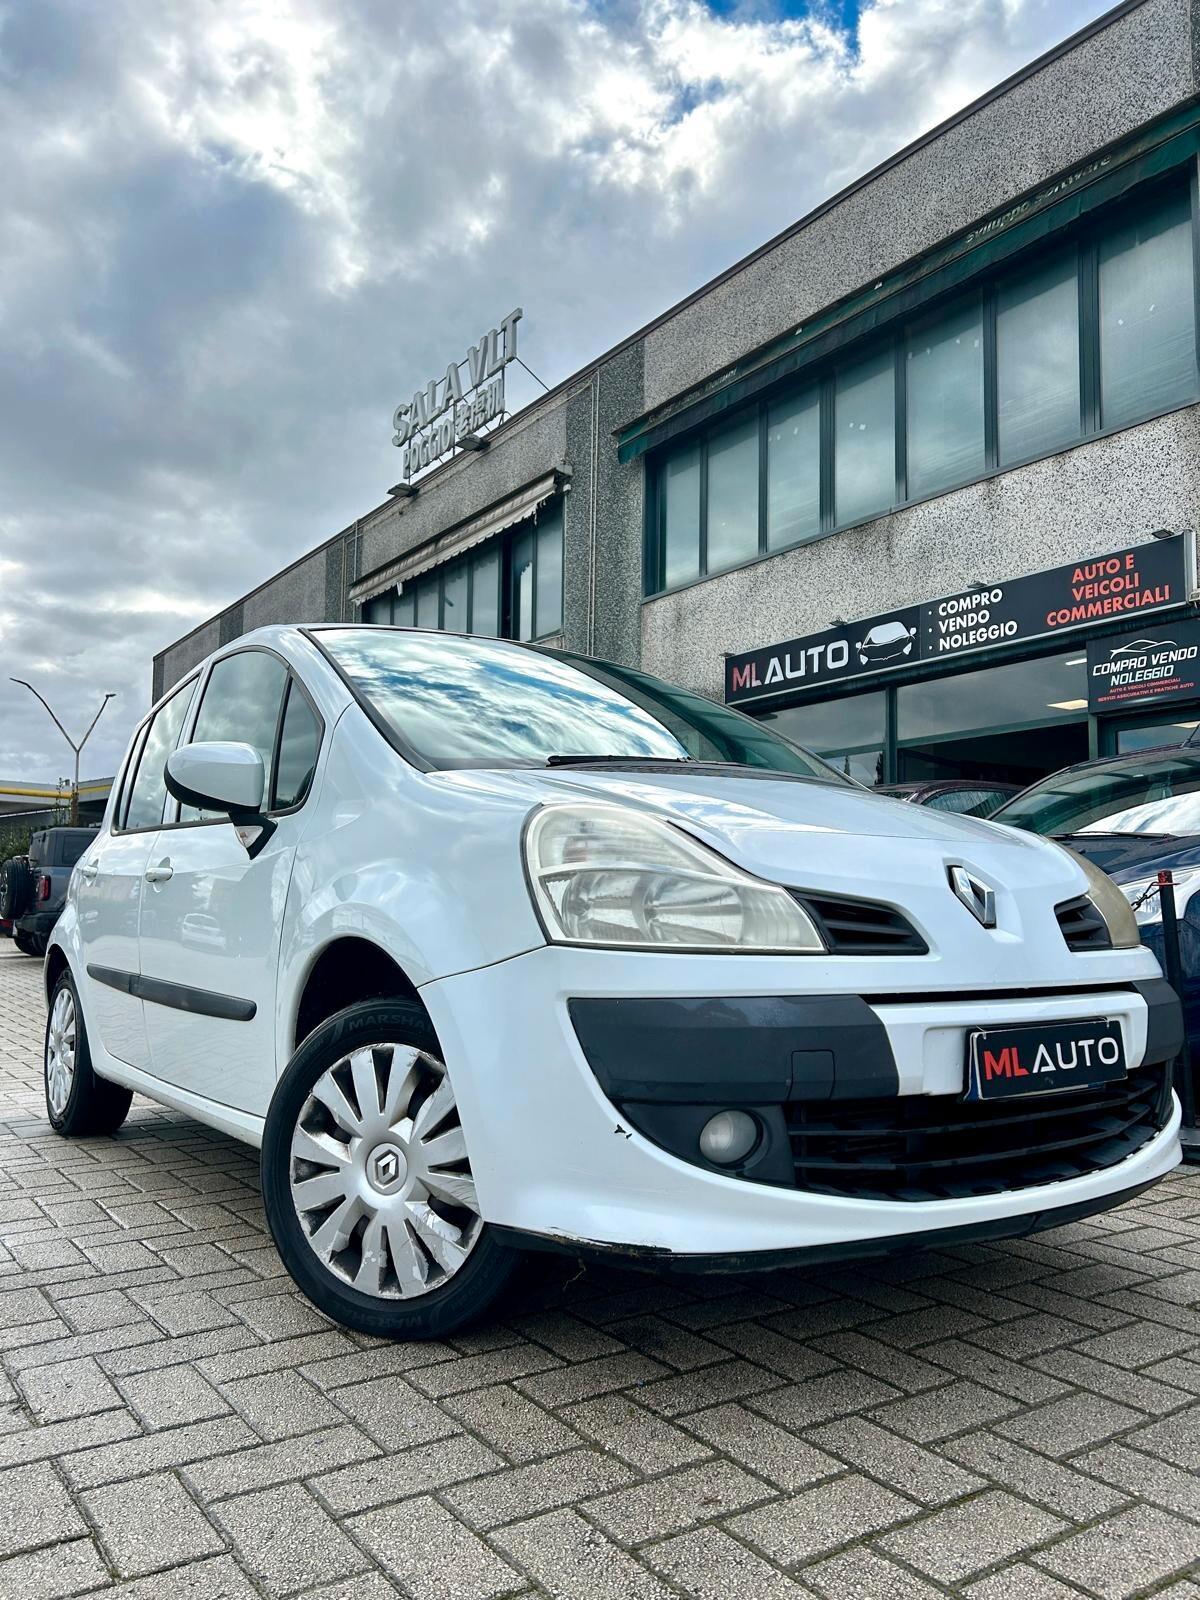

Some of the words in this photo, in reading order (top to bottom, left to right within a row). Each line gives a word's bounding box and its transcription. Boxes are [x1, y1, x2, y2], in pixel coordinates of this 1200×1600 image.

[391, 362, 462, 447] SALA
[466, 307, 523, 388] VLT
[402, 418, 455, 480] POGGIO
[1071, 557, 1121, 584] AUTO
[1124, 554, 1136, 571] E
[938, 588, 1003, 616] COMPRO
[1071, 571, 1140, 602] VEICOLI
[1046, 584, 1171, 627] COMMERCIALI
[938, 609, 990, 634] VENDO
[939, 620, 1018, 651] NOLEGGIO
[1092, 655, 1148, 677] COMPRO
[1151, 646, 1198, 666] VENDO
[1110, 664, 1175, 687] NOLEGGIO
[1109, 686, 1122, 694] AUTO
[1032, 1037, 1120, 1074] AUTO
